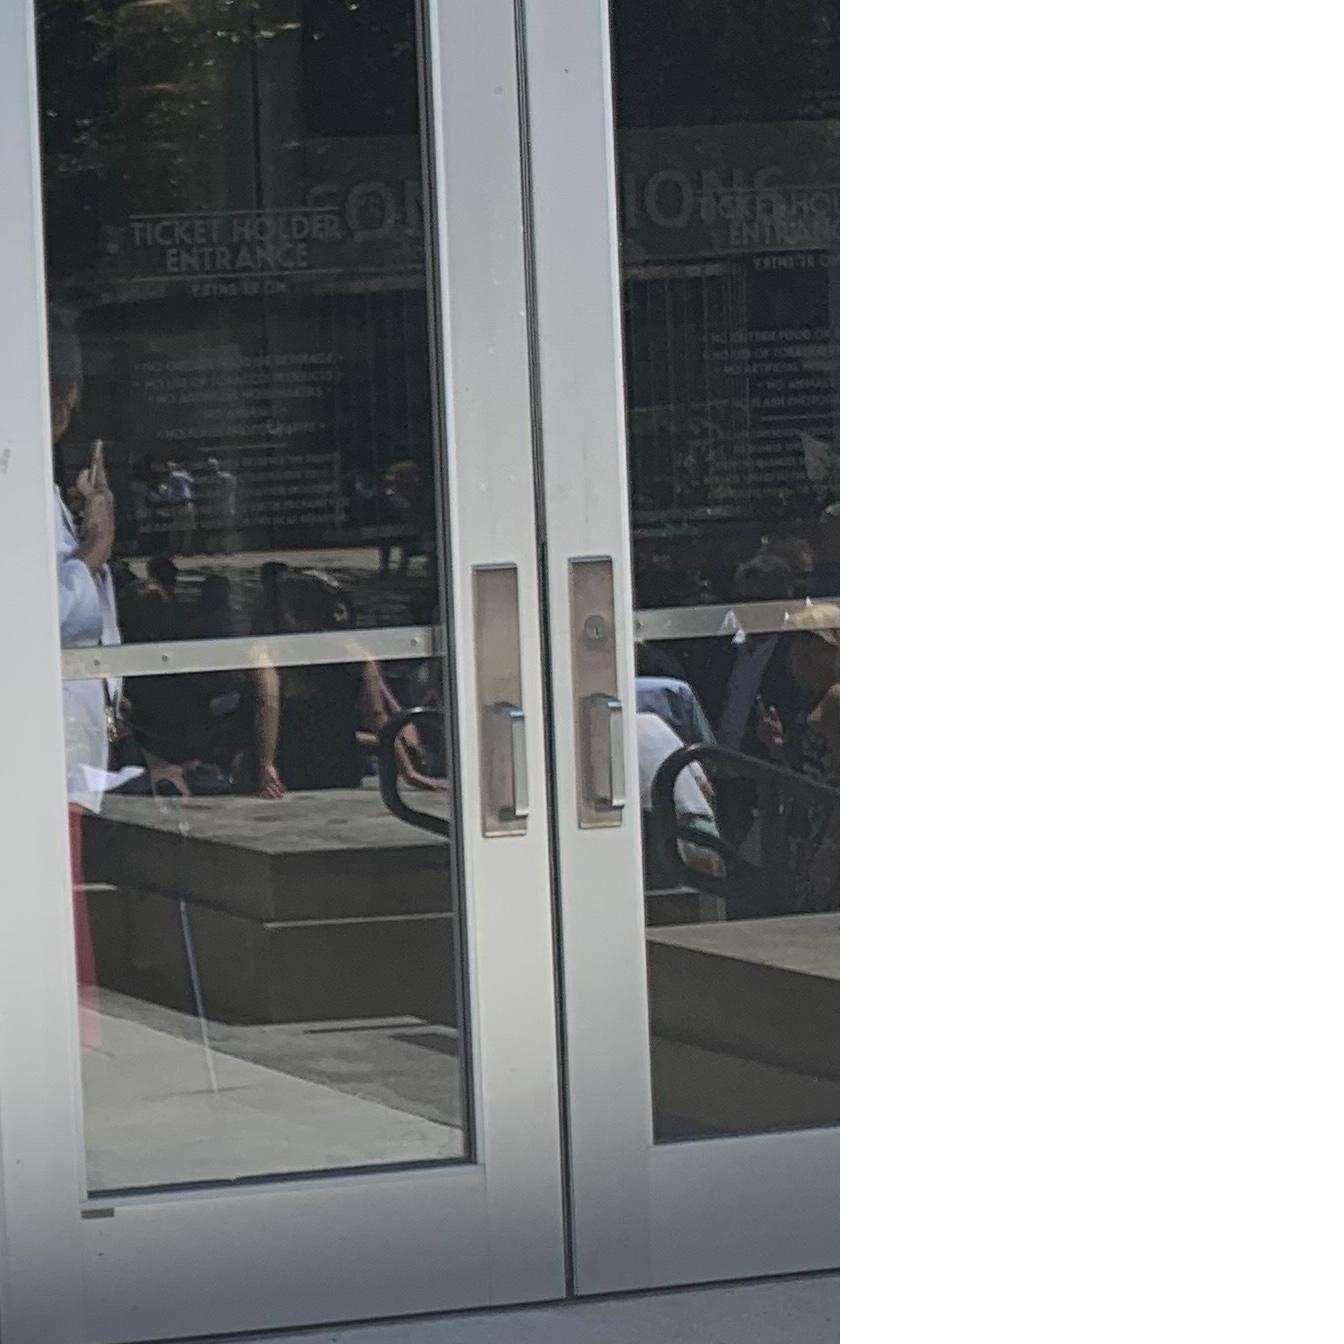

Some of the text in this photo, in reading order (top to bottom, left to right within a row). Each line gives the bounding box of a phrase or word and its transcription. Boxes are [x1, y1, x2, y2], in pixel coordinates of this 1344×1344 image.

[129, 214, 343, 247] TICKET HOLDER
[165, 242, 309, 273] ENTRANCE
